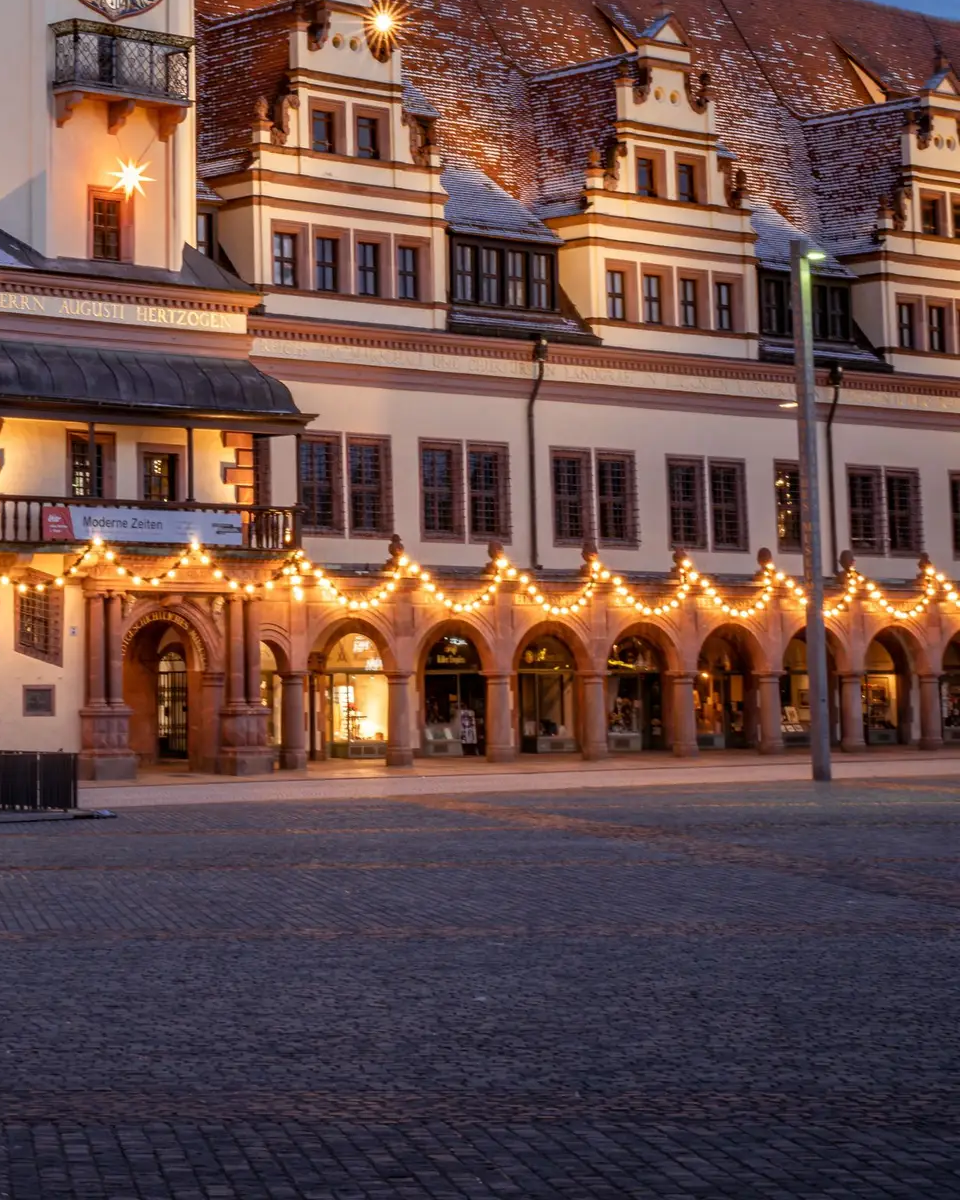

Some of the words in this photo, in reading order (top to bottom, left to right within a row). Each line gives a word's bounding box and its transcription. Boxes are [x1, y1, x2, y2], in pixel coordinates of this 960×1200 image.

[59, 300, 125, 320] AUGUSTI
[136, 305, 232, 329] HERTZOGEN
[83, 515, 128, 529] Moderne
[131, 517, 164, 530] Zeiten
